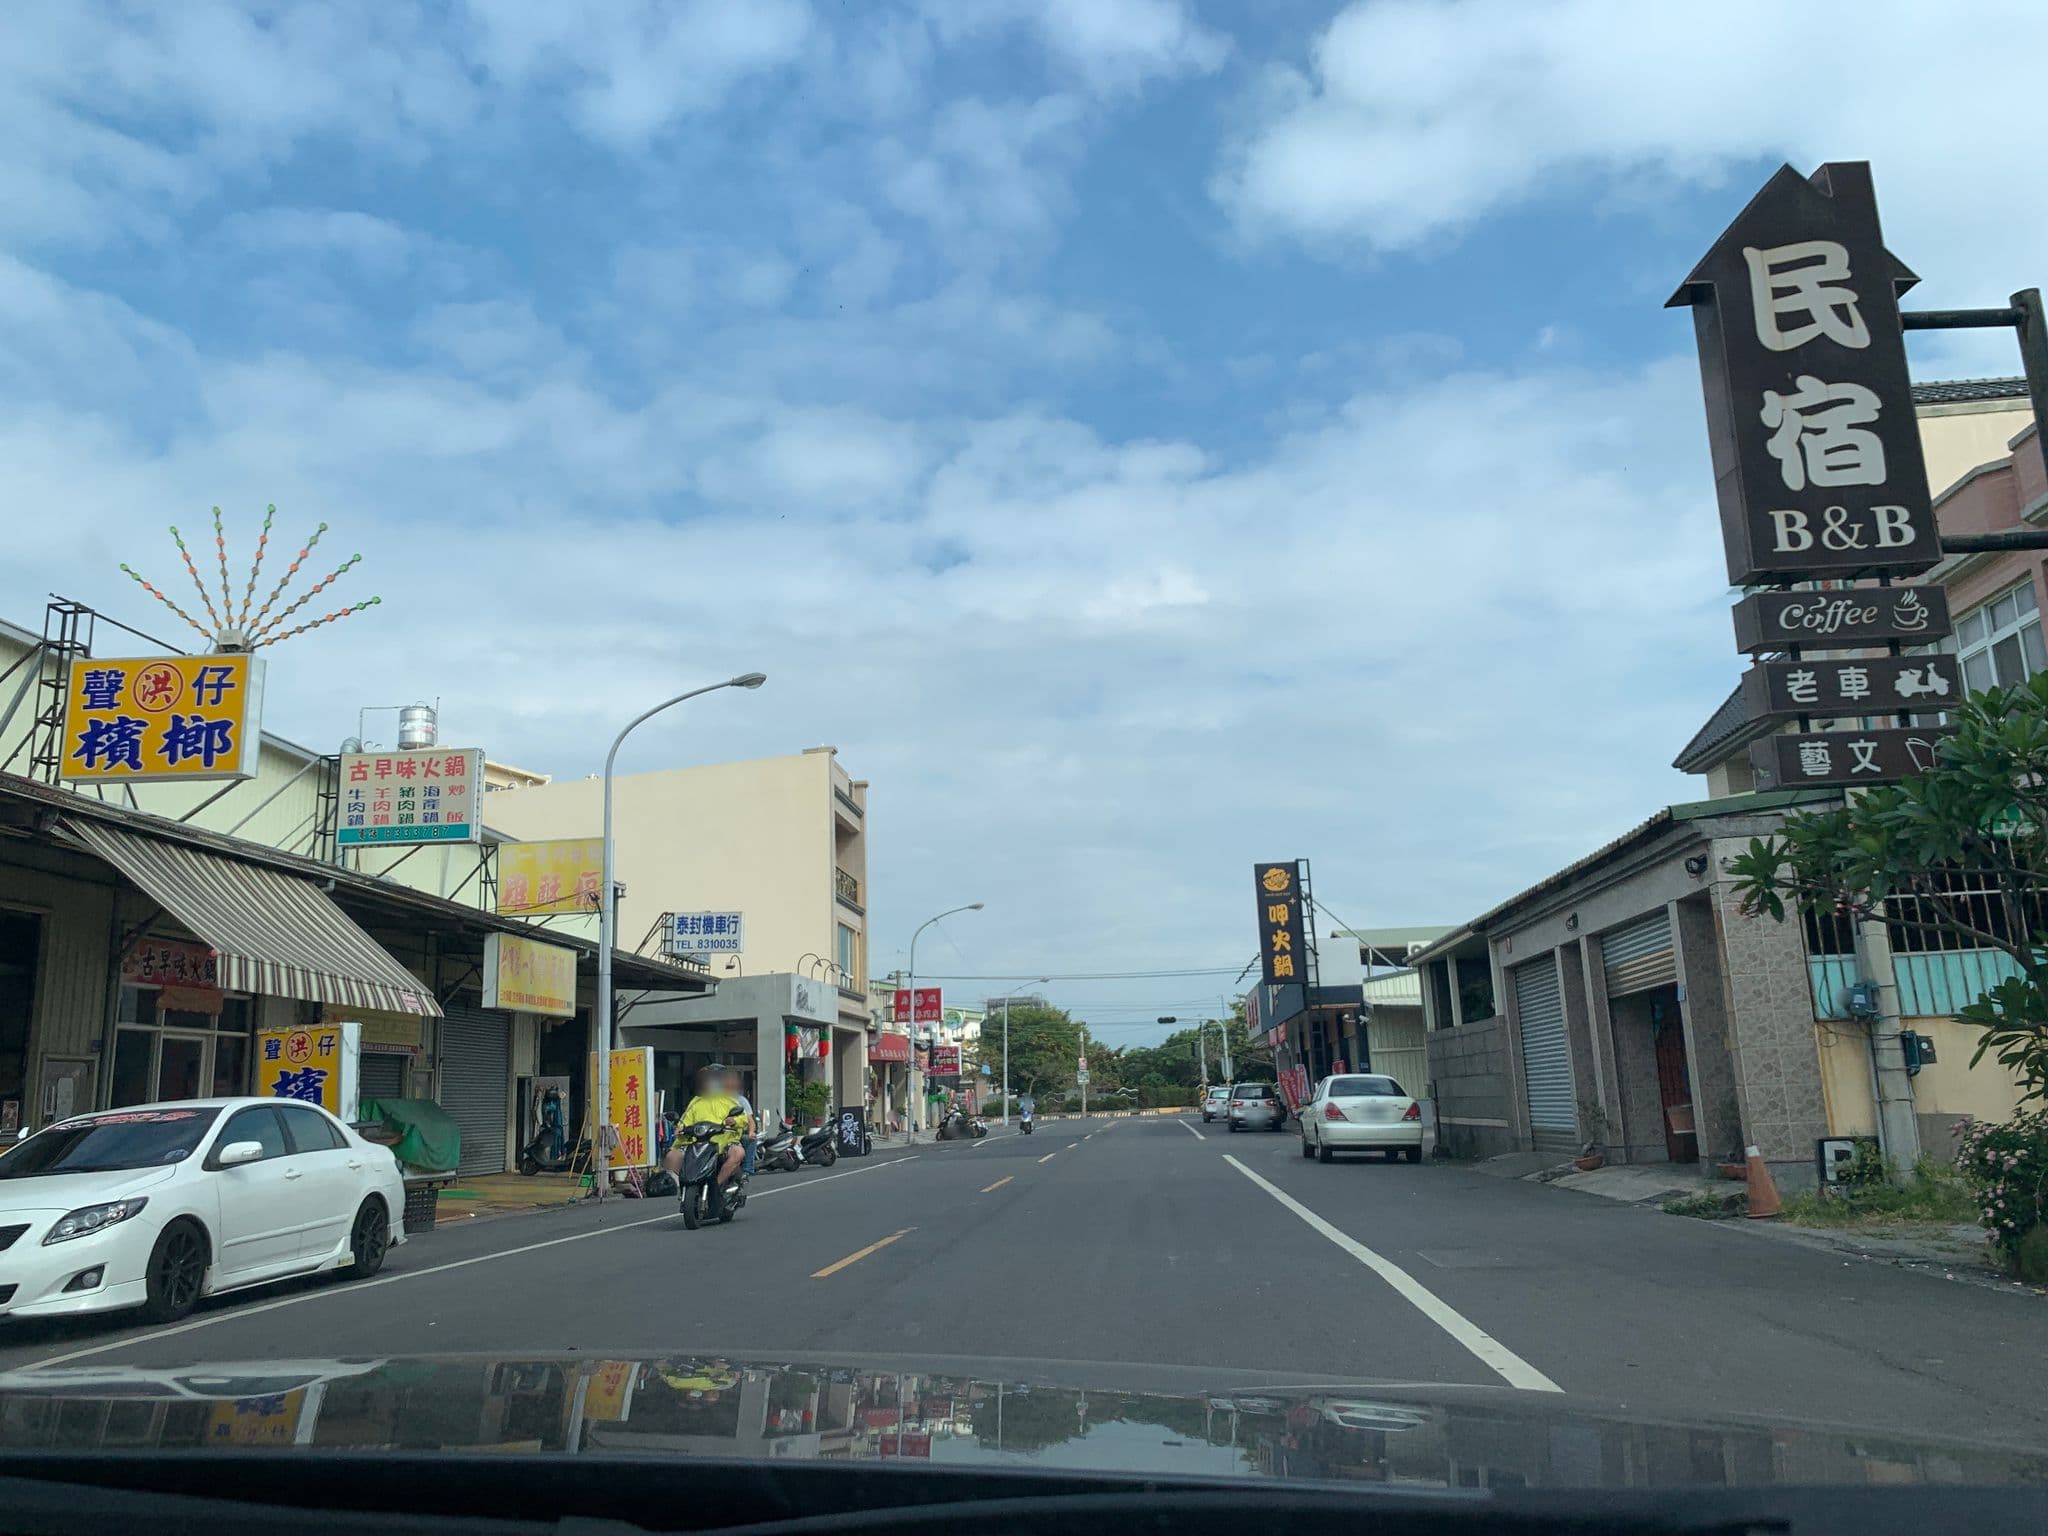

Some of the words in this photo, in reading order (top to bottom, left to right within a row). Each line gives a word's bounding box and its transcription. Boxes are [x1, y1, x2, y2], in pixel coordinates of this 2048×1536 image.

[1743, 240, 1887, 491] 民宿
[1768, 505, 1916, 552] B&B
[1779, 597, 1879, 633] Coffee
[1786, 666, 1871, 702] 老車
[72, 715, 235, 771] 檳榔
[1798, 739, 1881, 775] 藝文
[349, 755, 465, 782] 古早味火鍋
[347, 788, 366, 826] 牛肉鍋
[373, 788, 391, 826] 羊肉鍋
[677, 915, 739, 935] 泰封機車行
[676, 941, 693, 949] TEL
[697, 939, 738, 949] 8310035
[623, 1074, 643, 1160] 香雞排
